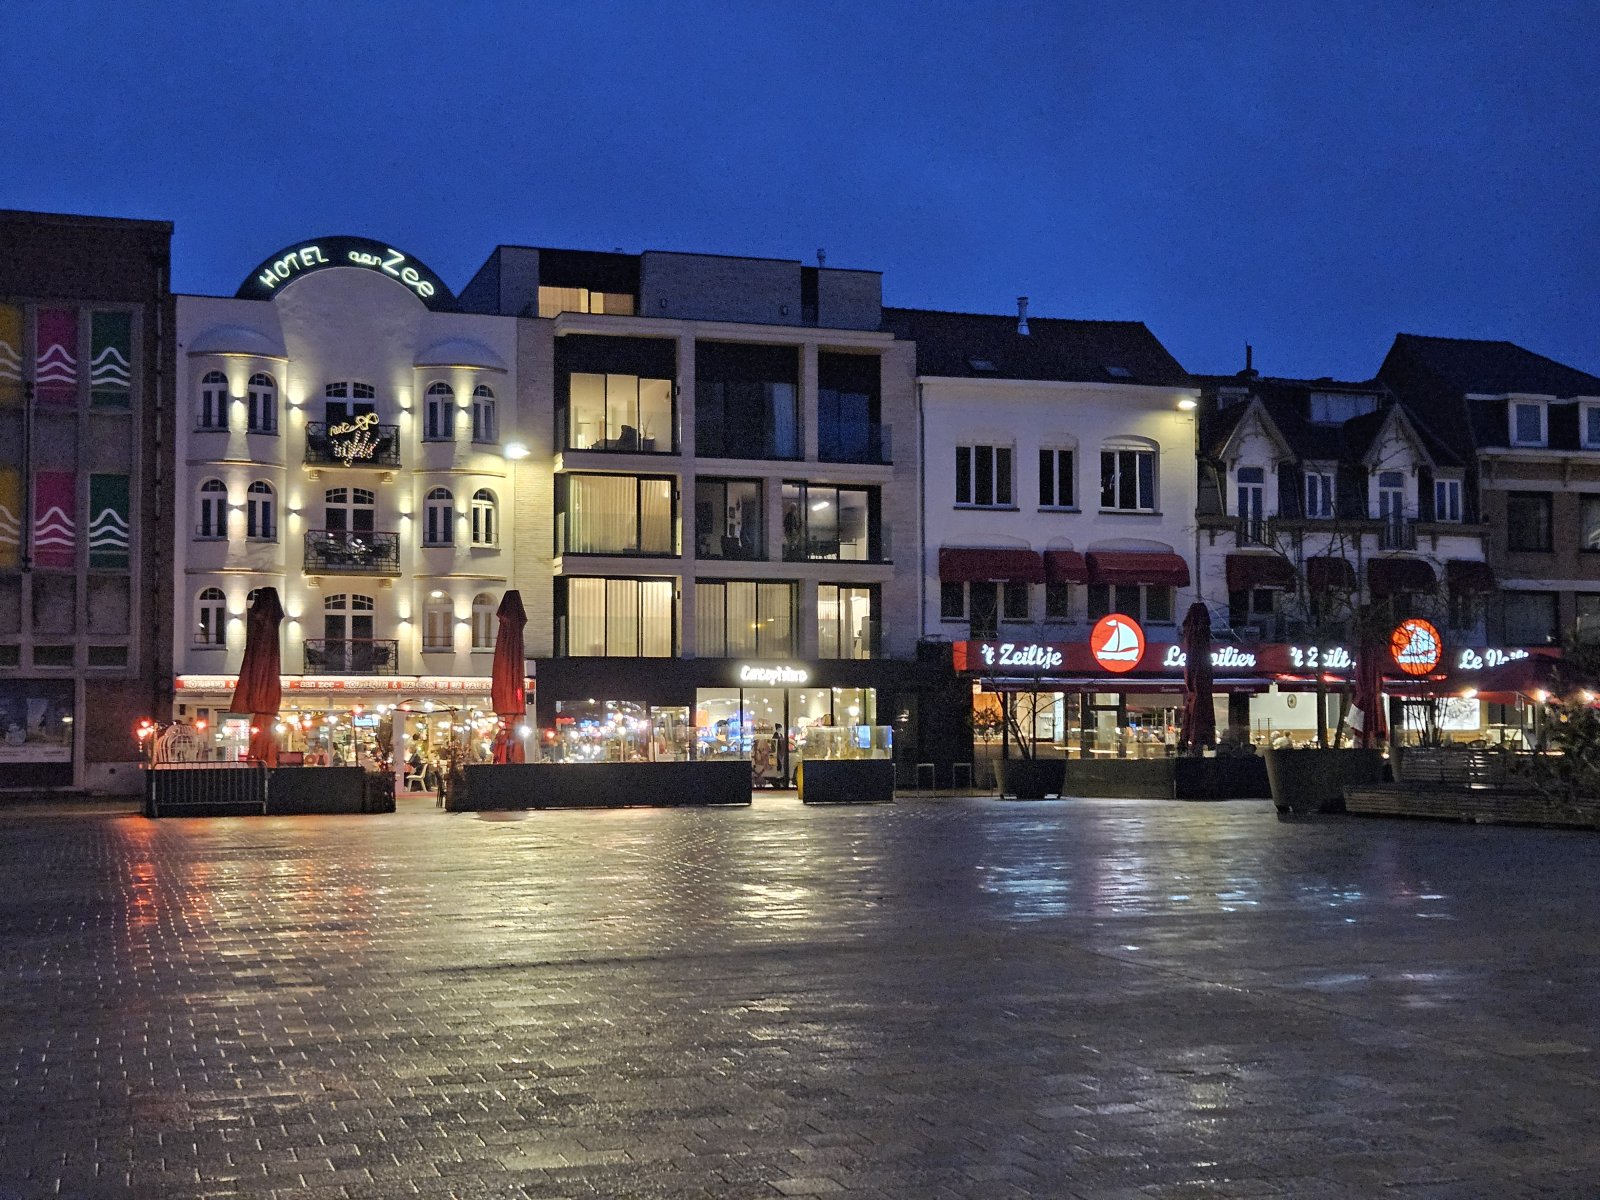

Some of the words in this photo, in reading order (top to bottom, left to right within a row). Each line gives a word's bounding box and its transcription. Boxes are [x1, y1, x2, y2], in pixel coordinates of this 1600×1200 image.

[259, 245, 329, 289] HOTEL
[981, 643, 995, 665] 't
[999, 643, 1063, 670] Zeiltje
[1163, 645, 1187, 667] Le
[1459, 648, 1483, 669] Le
